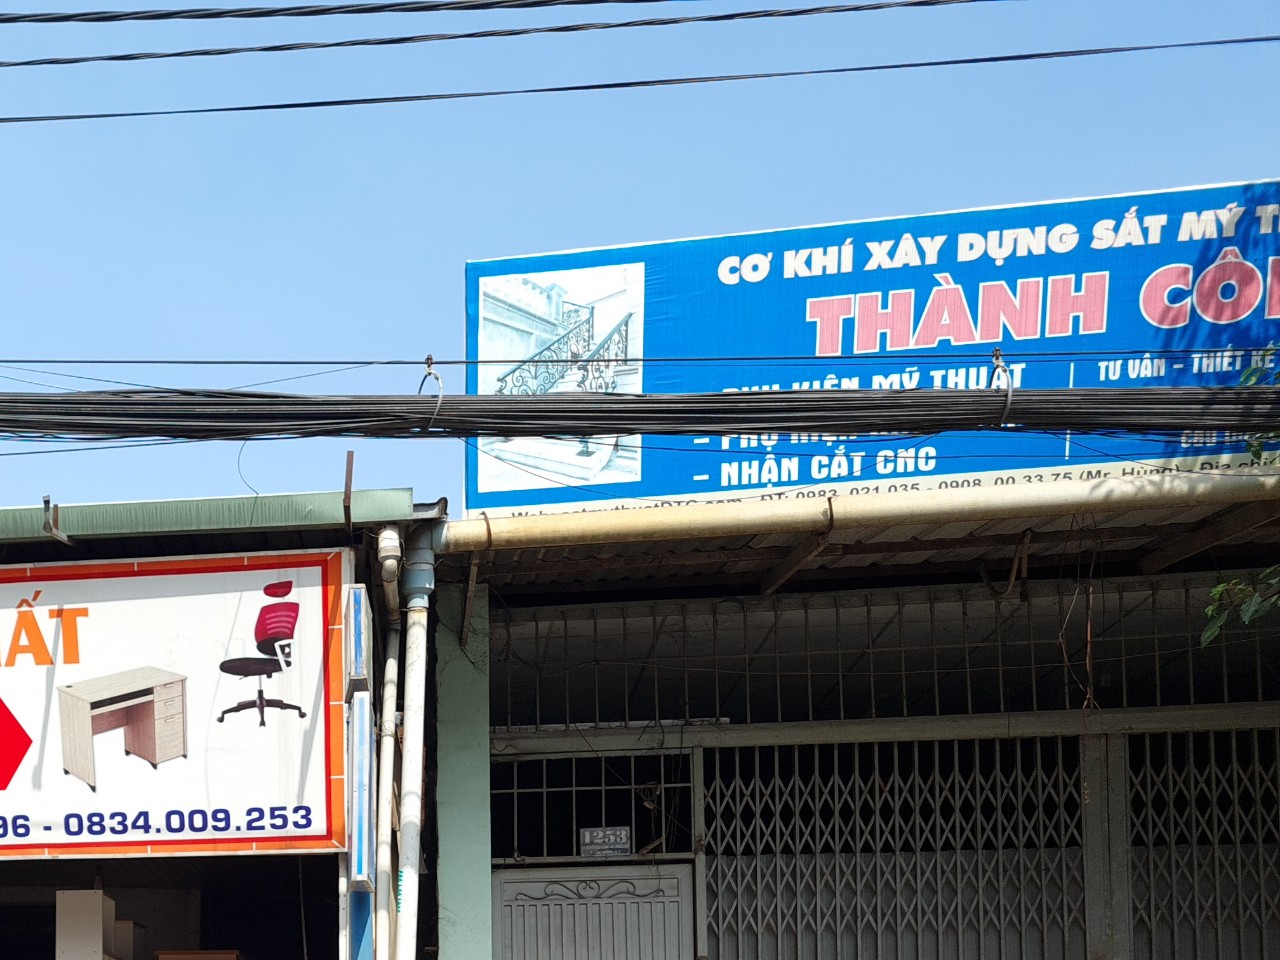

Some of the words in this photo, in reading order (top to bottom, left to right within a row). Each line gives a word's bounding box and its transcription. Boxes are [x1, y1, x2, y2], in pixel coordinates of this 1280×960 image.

[717, 252, 773, 285] CƠ
[783, 240, 854, 279] KHÍ
[864, 233, 949, 271] XÂY
[957, 222, 1080, 267] DỰNG
[1090, 205, 1168, 250] SẮT
[1177, 201, 1246, 242] MỸ
[1255, 204, 1280, 234] T
[806, 274, 1110, 357] THÀNH
[1139, 245, 1280, 329] CÔ
[1098, 360, 1124, 382] TƯ
[1191, 344, 1245, 374] THIẾT
[721, 454, 800, 488] NHẬN
[811, 445, 866, 480] CẮT
[875, 446, 938, 475] CNC
[64, 805, 312, 837] 0834.009.253
[583, 830, 627, 844] 1253
